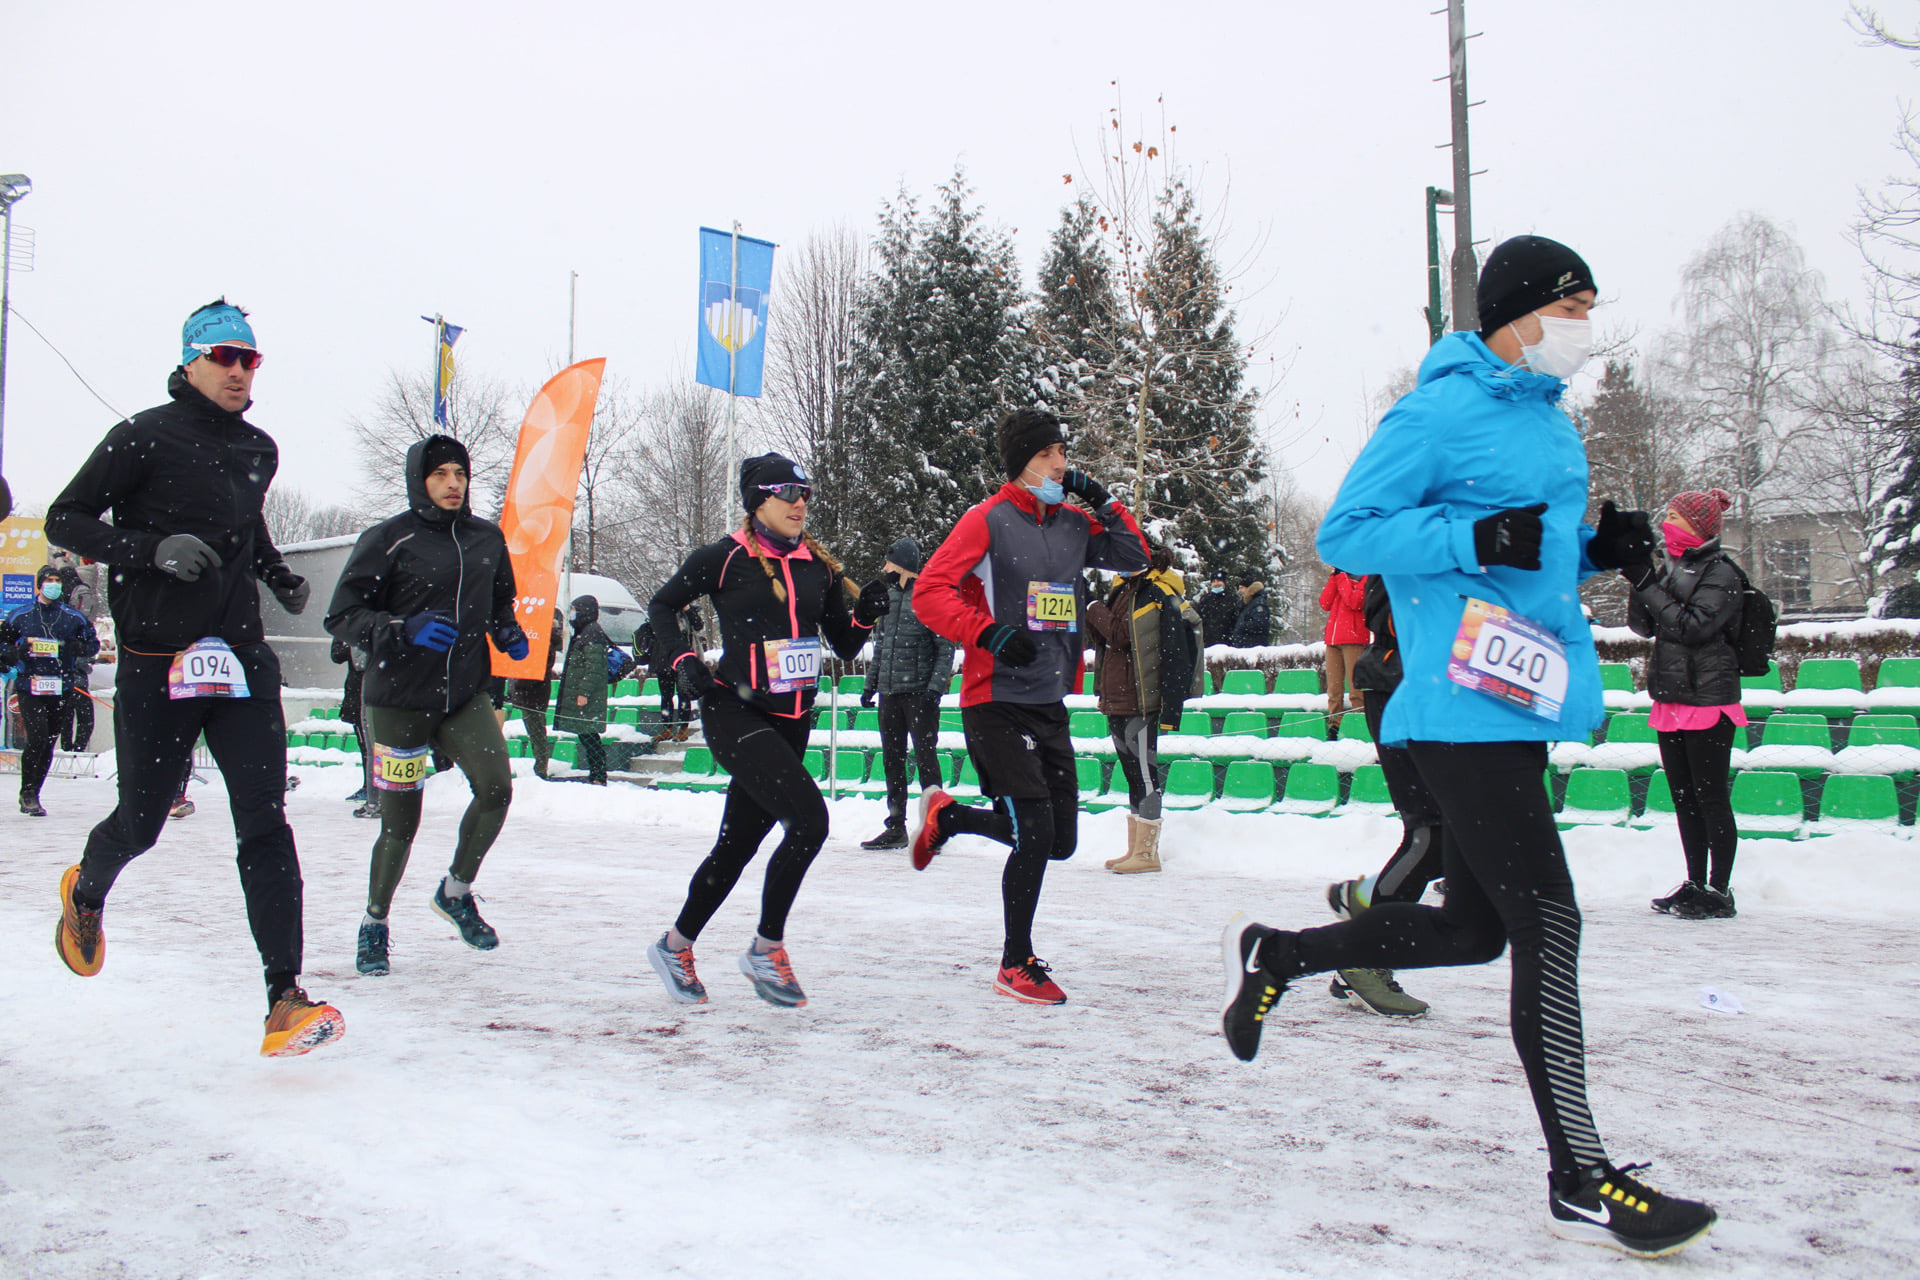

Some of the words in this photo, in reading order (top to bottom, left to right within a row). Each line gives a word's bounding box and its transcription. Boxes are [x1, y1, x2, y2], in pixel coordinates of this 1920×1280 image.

[1042, 597, 1073, 616] 121A
[34, 643, 56, 652] 132A
[191, 655, 230, 678] 094
[785, 653, 813, 673] 007
[1485, 635, 1547, 683] 040
[38, 681, 56, 689] 098
[386, 760, 424, 778] 148A
